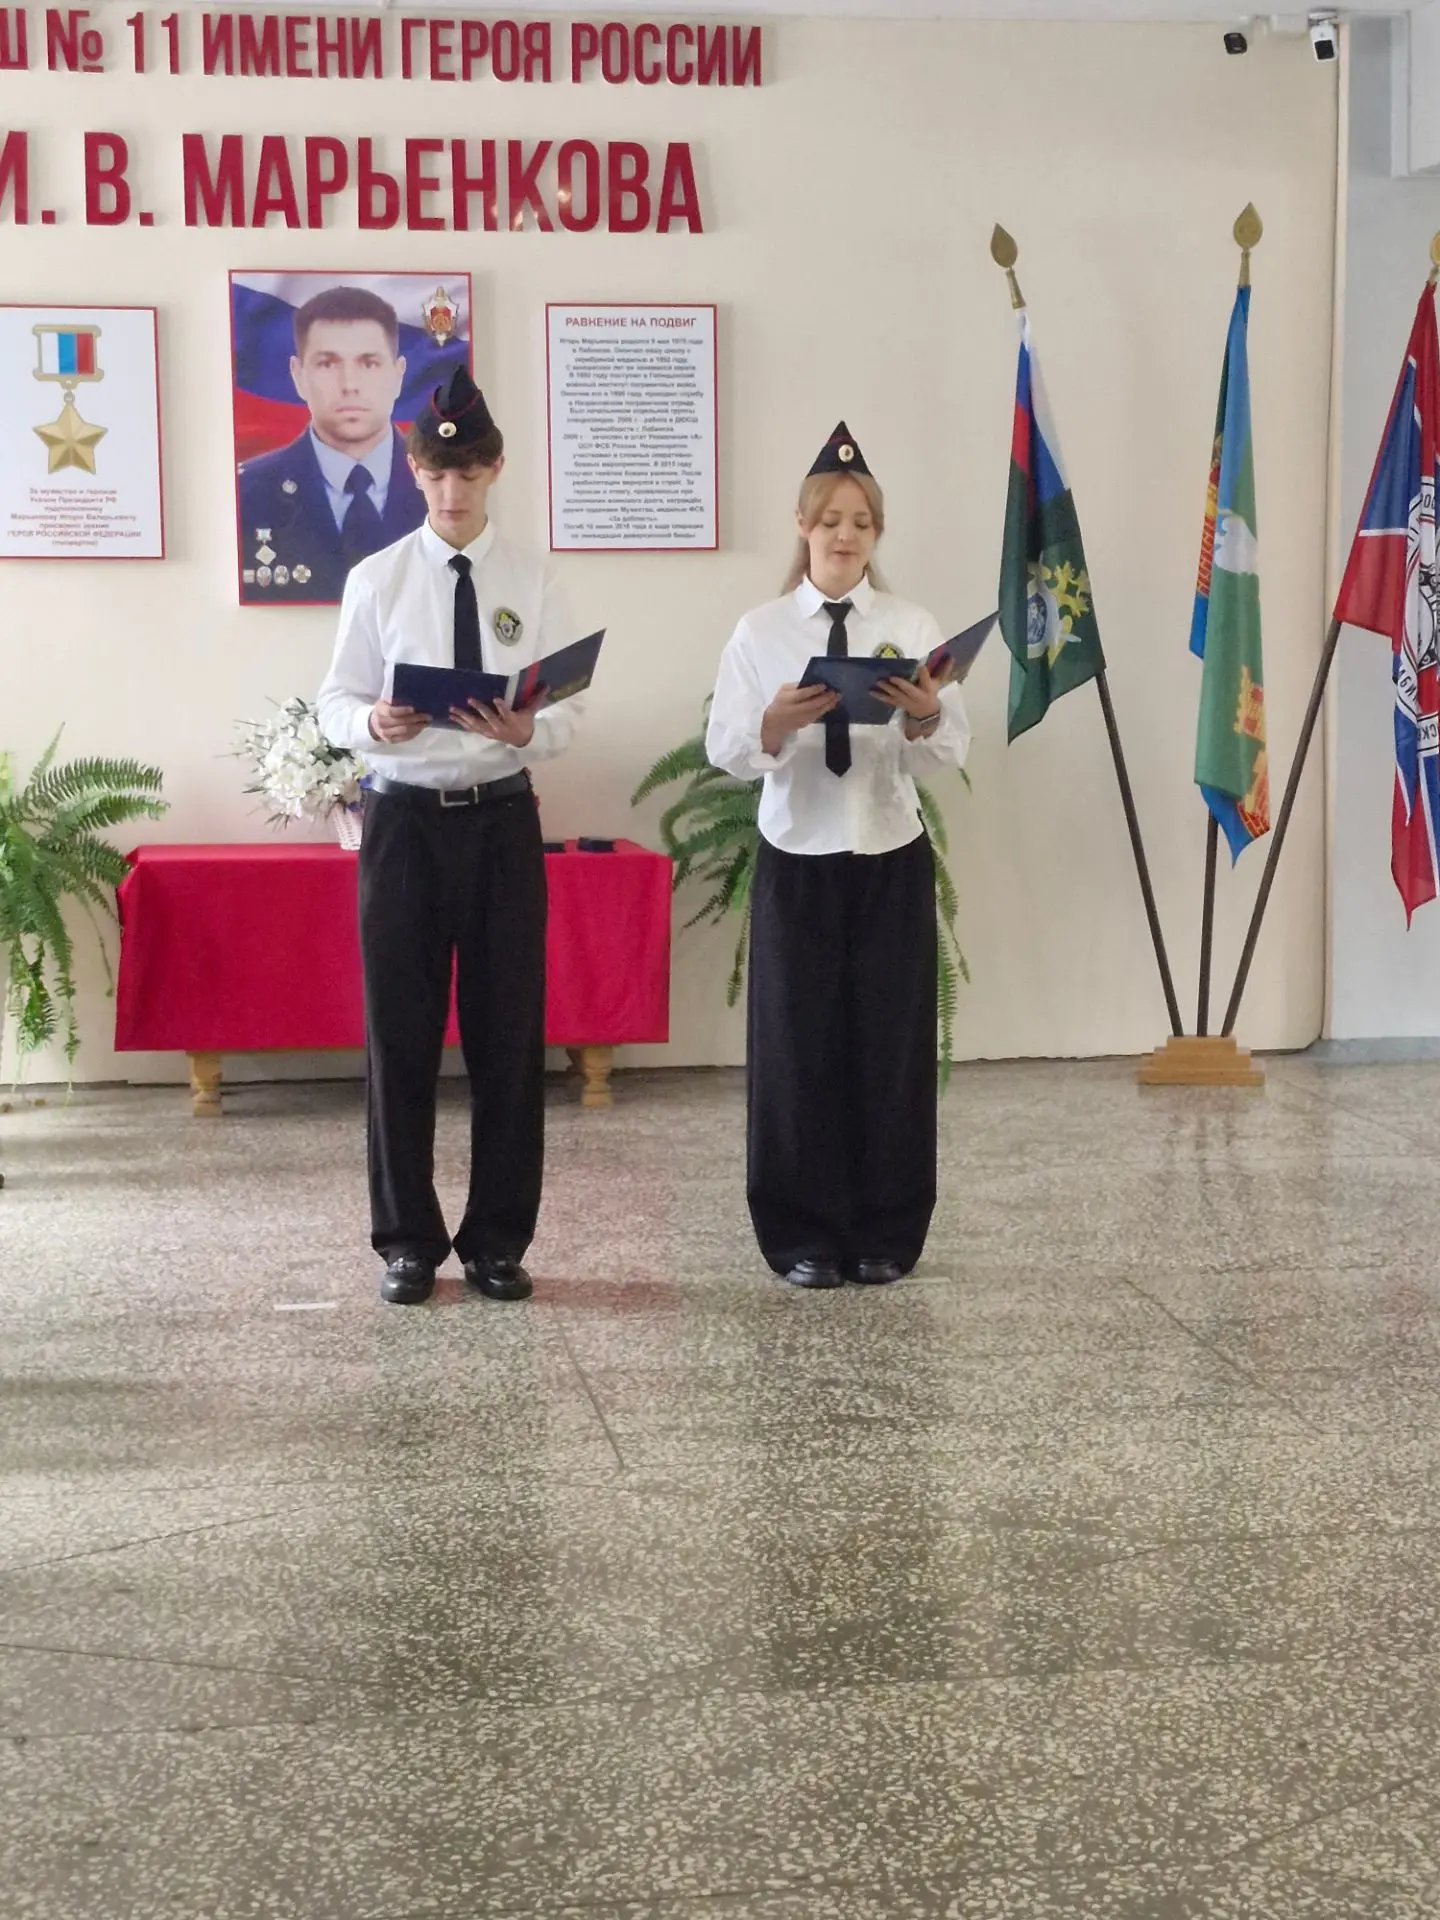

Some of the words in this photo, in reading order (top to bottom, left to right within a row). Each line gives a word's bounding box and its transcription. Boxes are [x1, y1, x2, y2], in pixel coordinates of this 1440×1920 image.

[46, 10, 104, 71] №
[127, 12, 180, 73] 11
[202, 14, 383, 79] ИМЕНИ
[400, 18, 552, 82] ГЕРОЯ
[571, 22, 761, 86] РОССИИ
[84, 132, 153, 226] В.
[182, 133, 702, 232] МАРЬЕНКОВА
[565, 317, 627, 327] РАВНЕНИЕ
[630, 317, 647, 327] НА
[649, 317, 697, 327] ПОДВИГ
